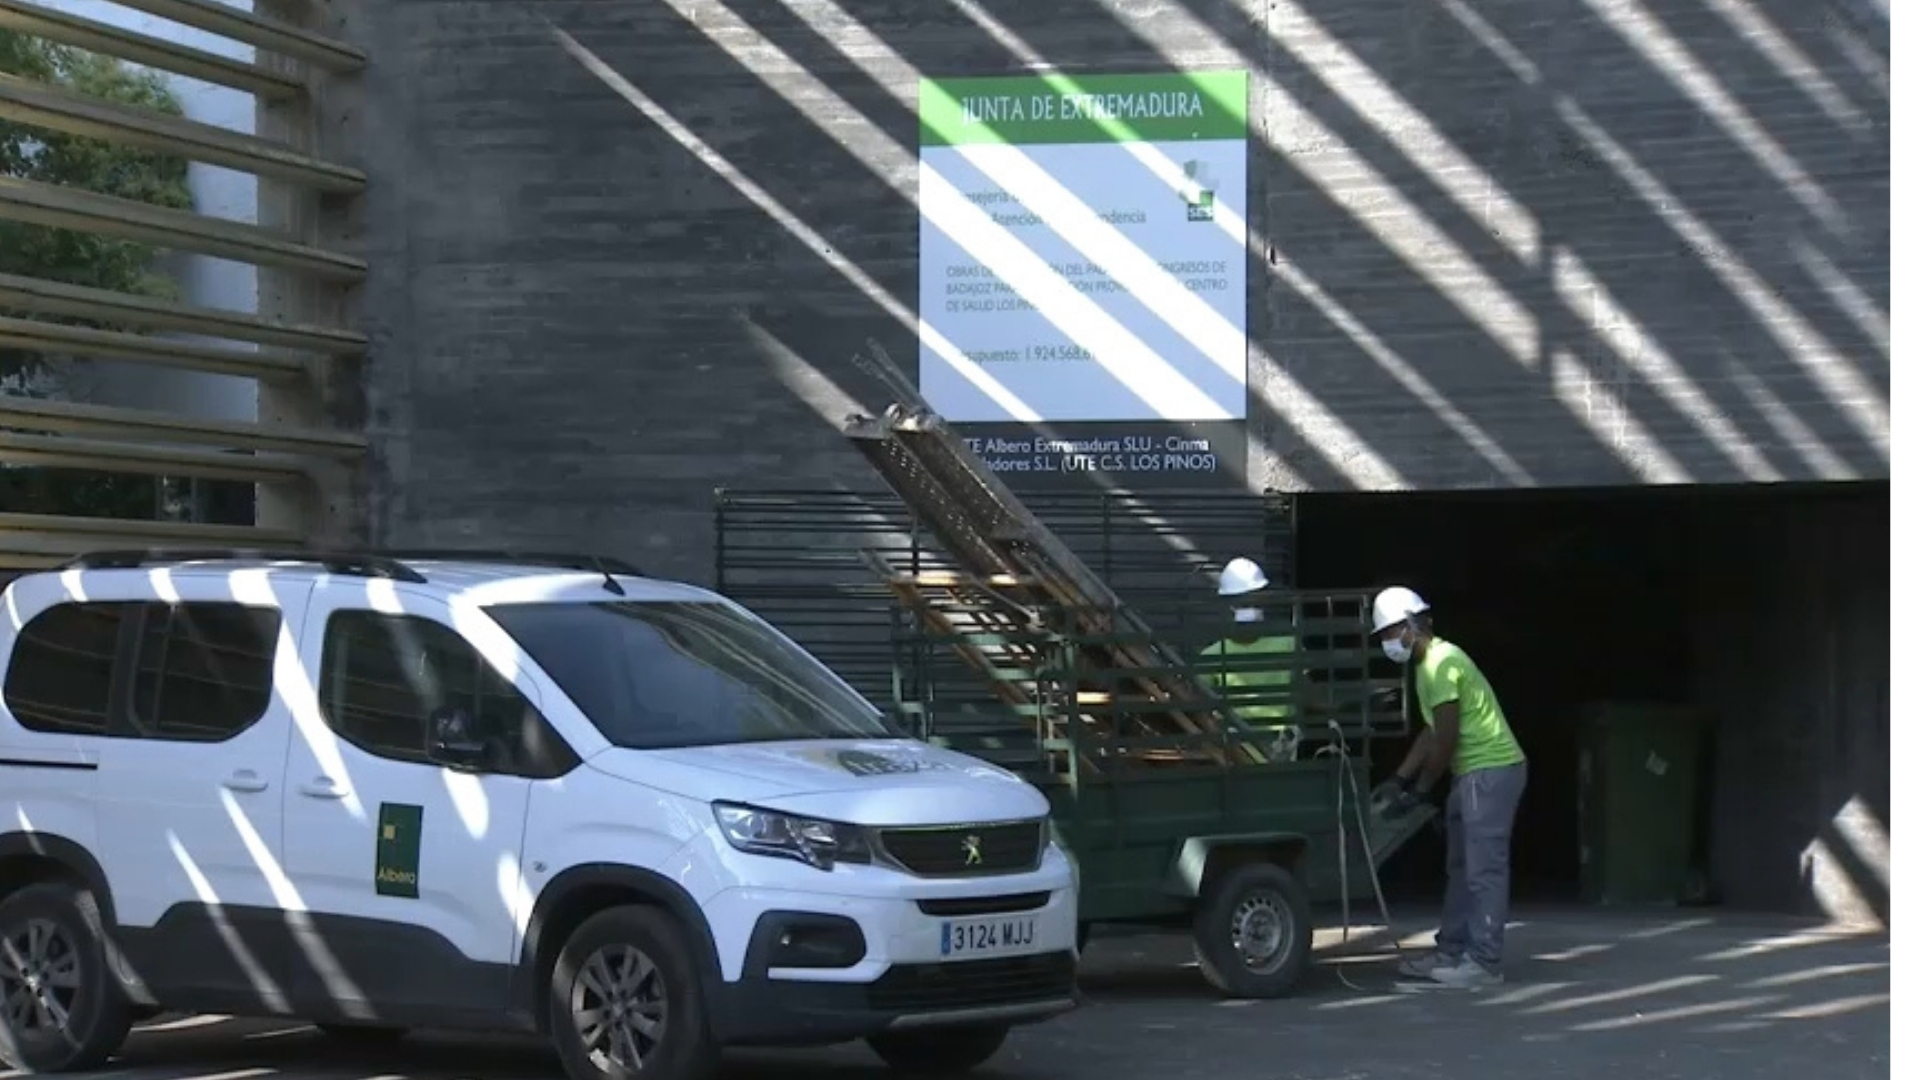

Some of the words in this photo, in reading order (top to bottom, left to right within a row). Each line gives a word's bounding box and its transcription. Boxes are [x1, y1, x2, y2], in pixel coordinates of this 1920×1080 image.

[1031, 95, 1054, 121] DE
[1060, 91, 1204, 120] EXTREMADURA
[1212, 260, 1226, 273] DE
[985, 437, 1031, 454] Albero
[1033, 435, 1120, 453] Extremadura
[1123, 436, 1152, 452] SLU
[1165, 436, 1209, 452] Cinma
[1033, 456, 1057, 471] S.L.
[1060, 454, 1096, 474] (UTE
[1100, 455, 1126, 471] C.S.
[1130, 454, 1160, 471] LOS
[1163, 453, 1216, 473] PINOS)
[377, 866, 416, 885] Albero
[954, 923, 998, 951] 3124
[1002, 920, 1034, 946] MJJ
